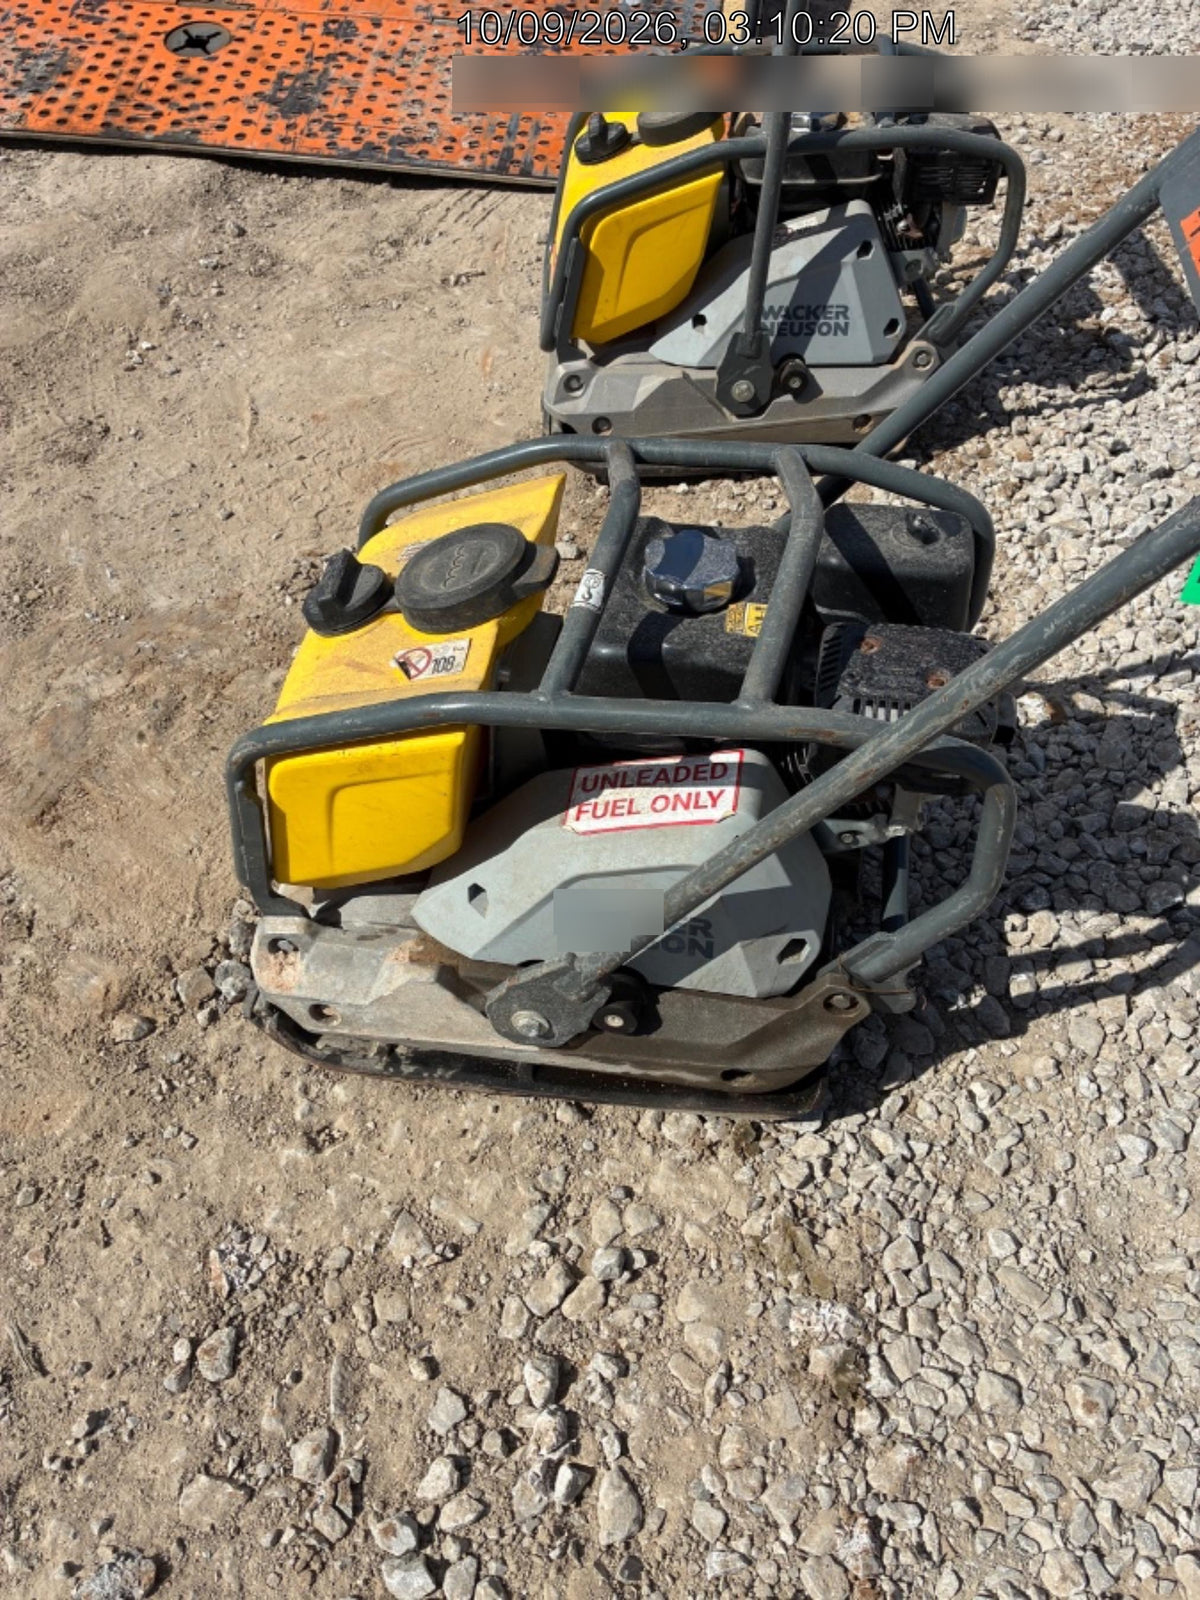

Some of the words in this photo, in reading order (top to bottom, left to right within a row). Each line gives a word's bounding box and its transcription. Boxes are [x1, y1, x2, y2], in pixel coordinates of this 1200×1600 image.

[761, 304, 850, 320] WACKER
[431, 655, 456, 675] 108
[580, 762, 729, 794] UNLEADED
[575, 797, 641, 822] FUEL
[650, 788, 727, 814] ONLY
